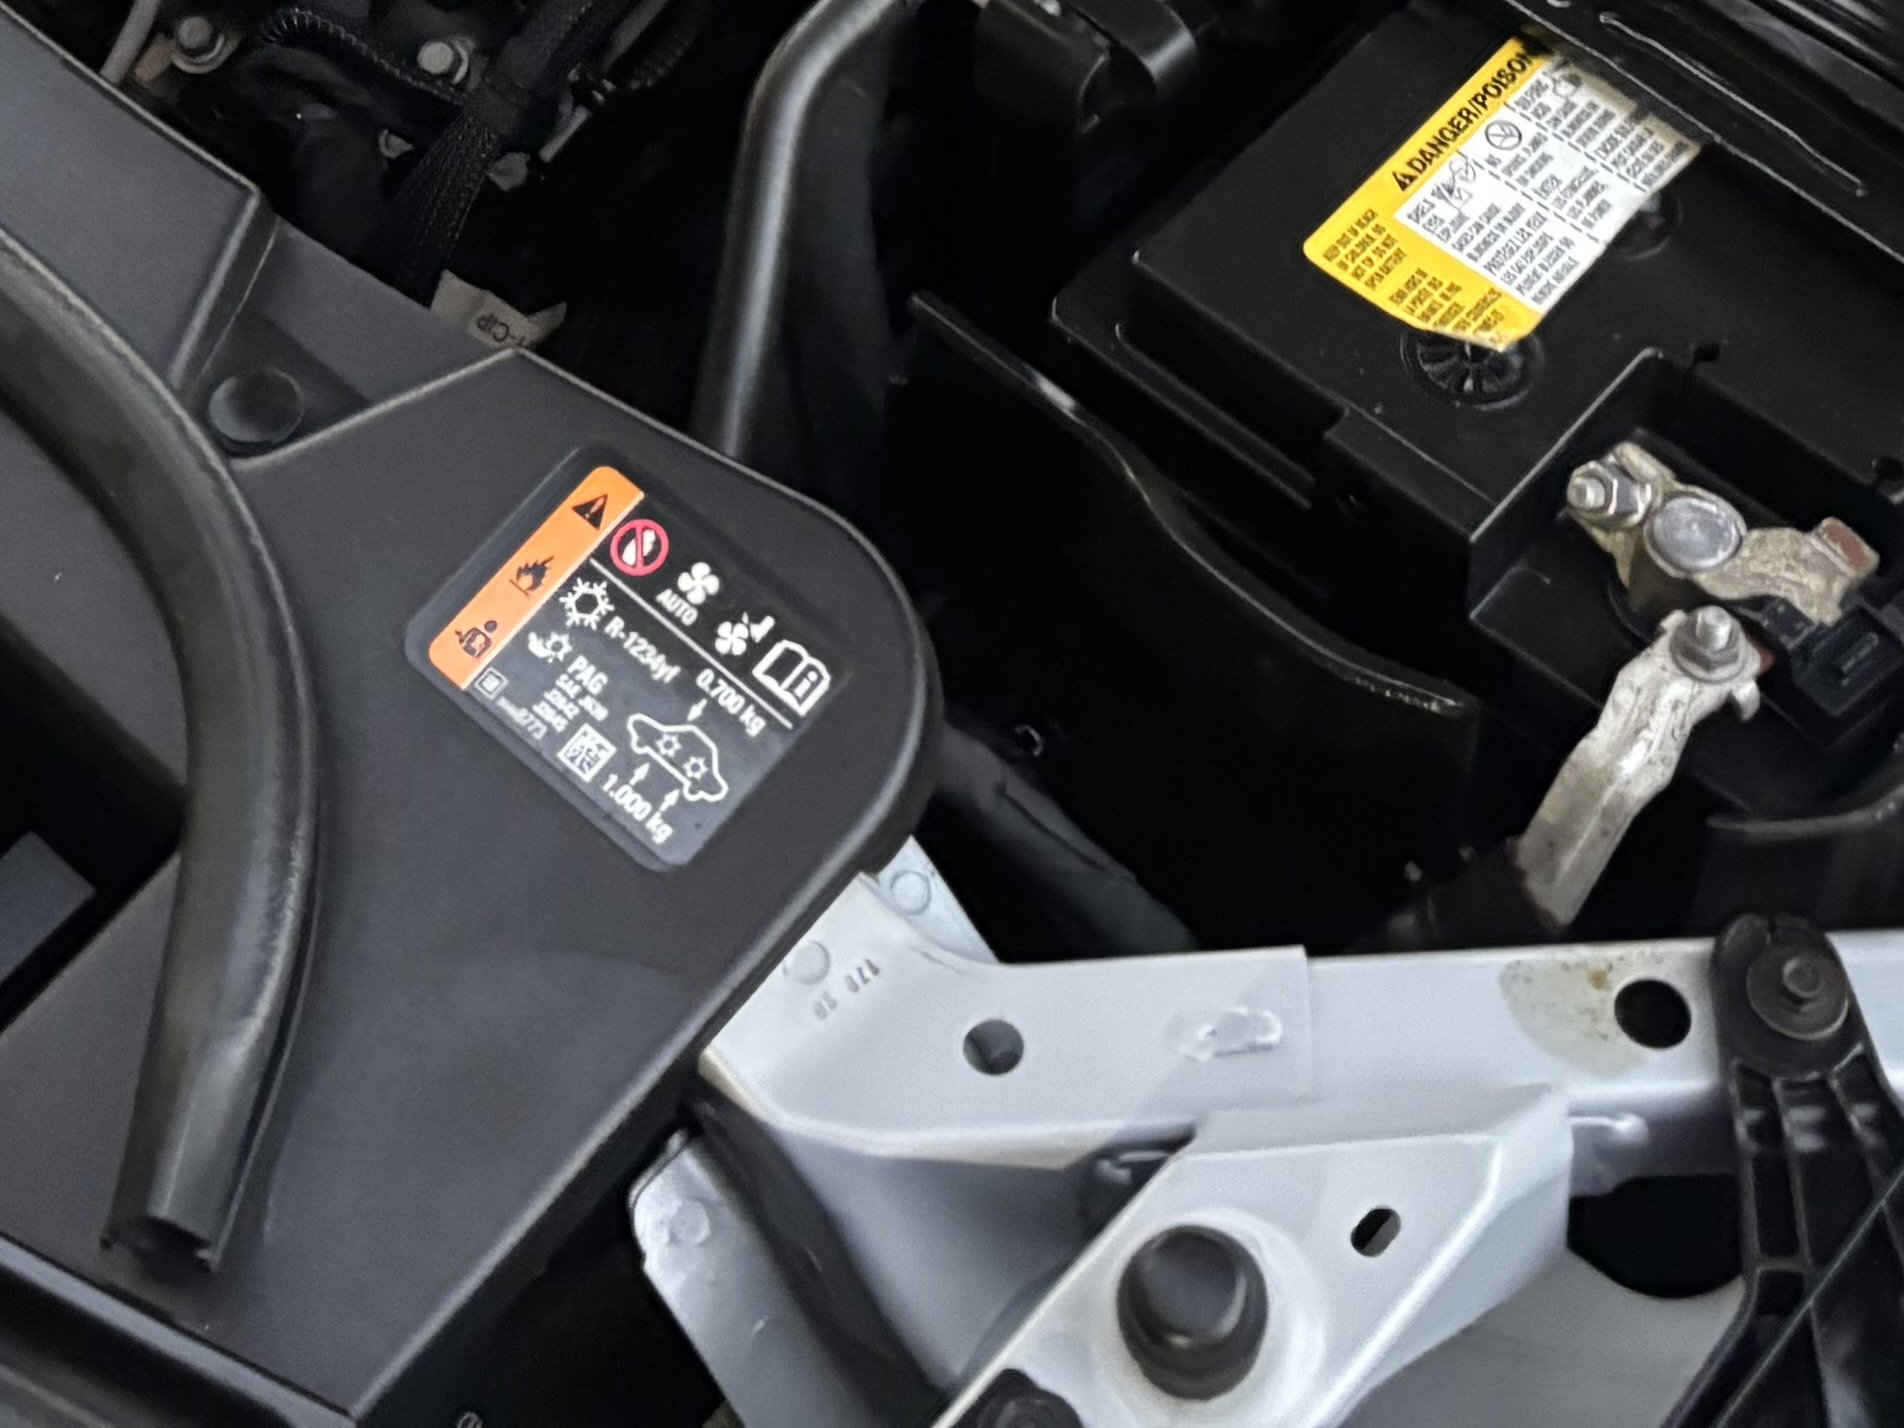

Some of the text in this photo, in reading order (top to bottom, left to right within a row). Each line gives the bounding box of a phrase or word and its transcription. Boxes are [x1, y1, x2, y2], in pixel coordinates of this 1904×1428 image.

[1411, 36, 1543, 174] DANGER/POISON
[655, 587, 698, 627] AUTO
[566, 654, 610, 694] PAG
[602, 615, 768, 737] R-1234yf 0.700 kg
[601, 770, 676, 845] 1.000 kg
